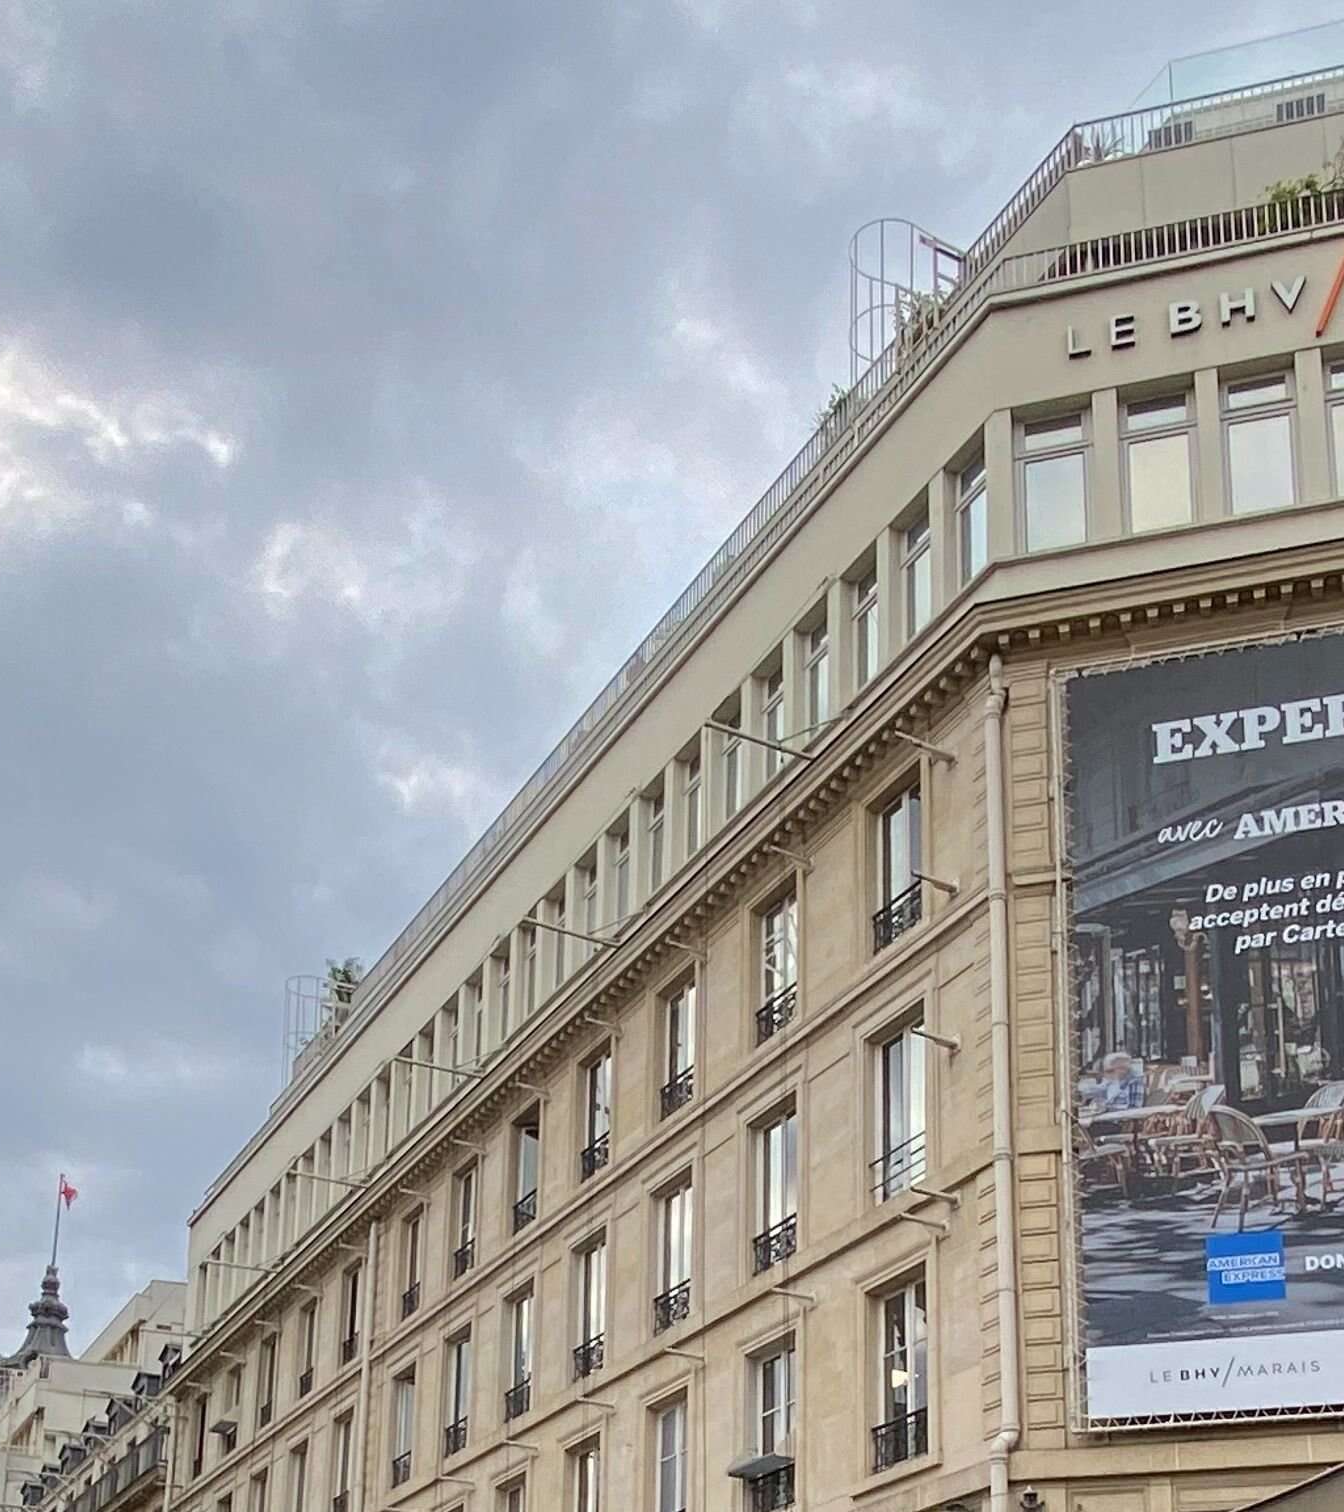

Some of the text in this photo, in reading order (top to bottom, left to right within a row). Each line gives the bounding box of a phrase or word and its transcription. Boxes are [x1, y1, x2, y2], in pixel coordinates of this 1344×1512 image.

[1157, 818, 1223, 845] avec
[1205, 882, 1237, 903] De
[1242, 874, 1295, 907] plus
[1300, 873, 1330, 890] en
[1189, 900, 1309, 931] acceptent
[1235, 927, 1278, 955] par
[1207, 1255, 1279, 1271] AMERICAN
[1223, 1269, 1285, 1283] EXPRESS
